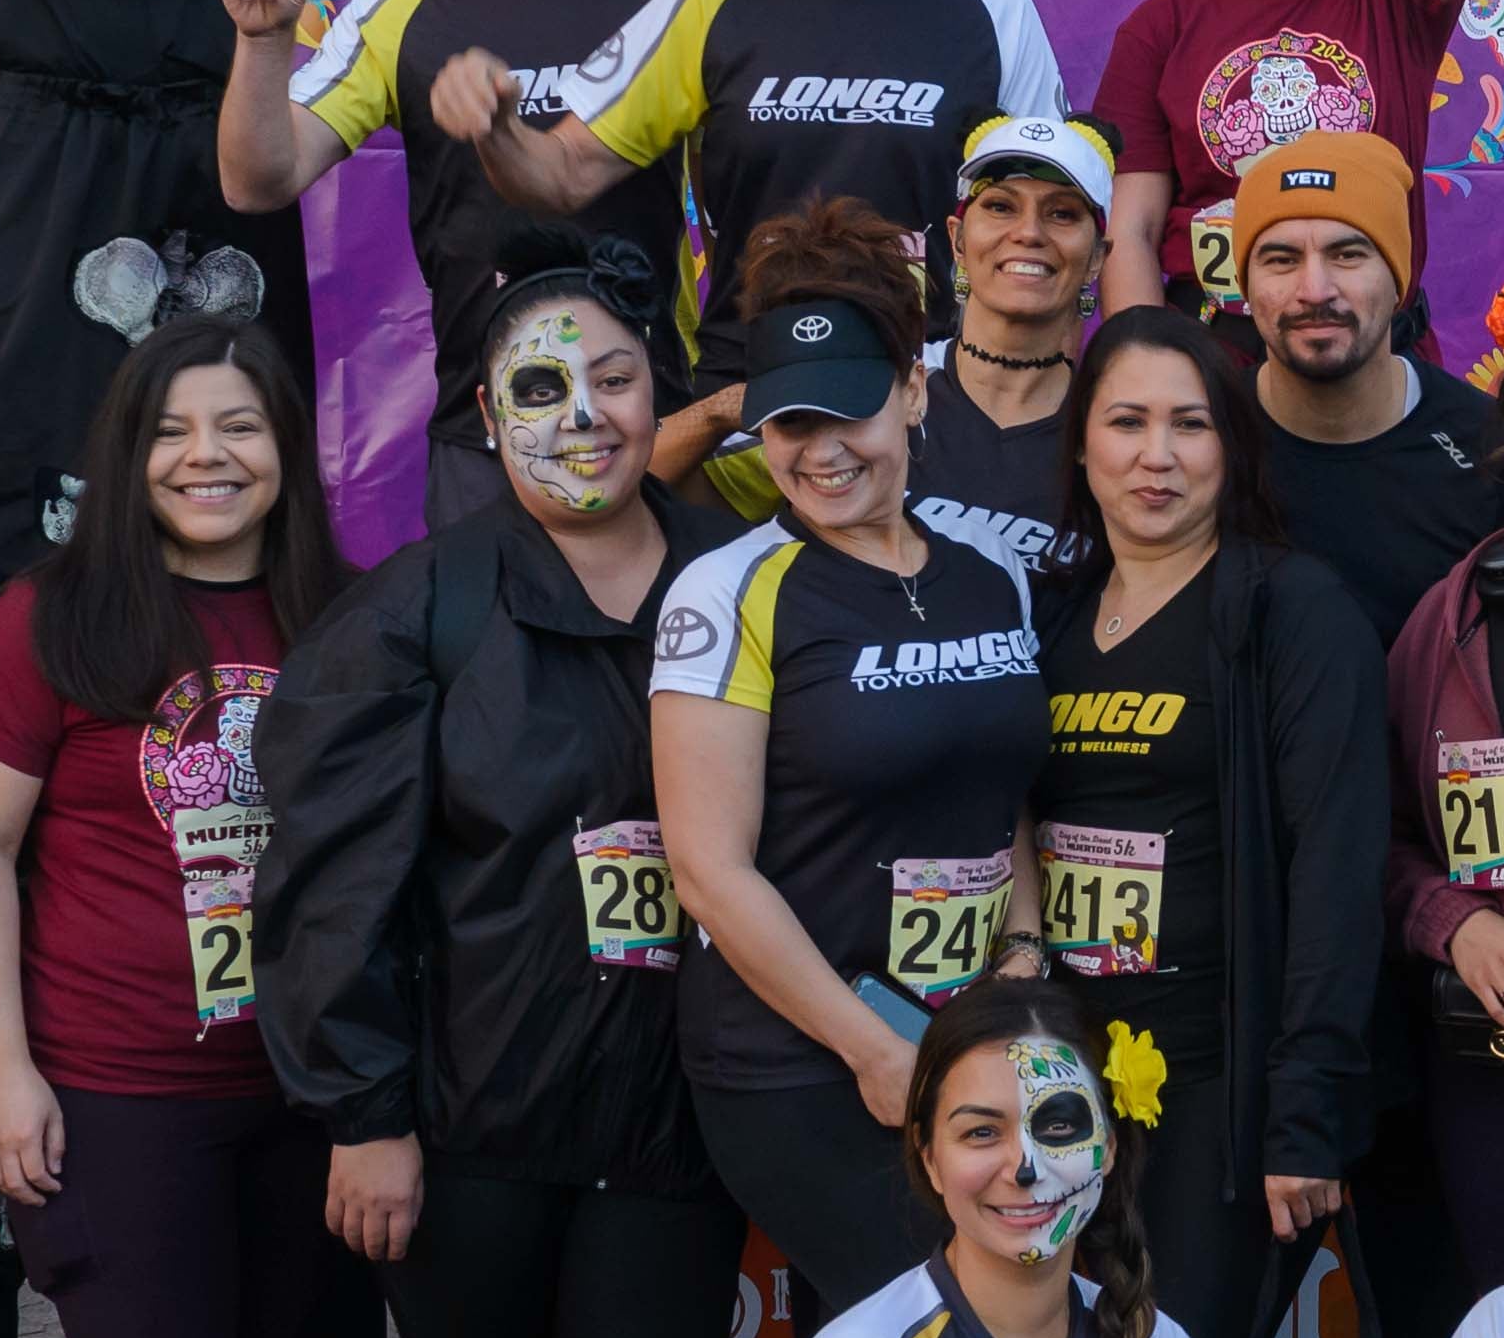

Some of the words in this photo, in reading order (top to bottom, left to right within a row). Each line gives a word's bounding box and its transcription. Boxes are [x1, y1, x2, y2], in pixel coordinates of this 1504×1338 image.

[1311, 39, 1352, 72] 2023
[749, 76, 945, 113] LONGO
[746, 106, 826, 122] TOYOTA
[826, 107, 935, 127] LEXUS
[1286, 171, 1330, 187] YETI
[1198, 232, 1232, 287] 2
[1431, 431, 1474, 469] 2XU
[851, 628, 1033, 678] LONGO
[850, 669, 955, 692] TOYOTA
[955, 660, 1040, 681] LEXUS
[1049, 690, 1186, 736] ONGO
[1061, 742, 1078, 754] TO
[1080, 740, 1151, 755] WELLNESS
[1066, 842, 1112, 855] MUERTOS
[1114, 839, 1137, 857] 5k
[590, 864, 676, 935] 28
[201, 924, 253, 992] 2
